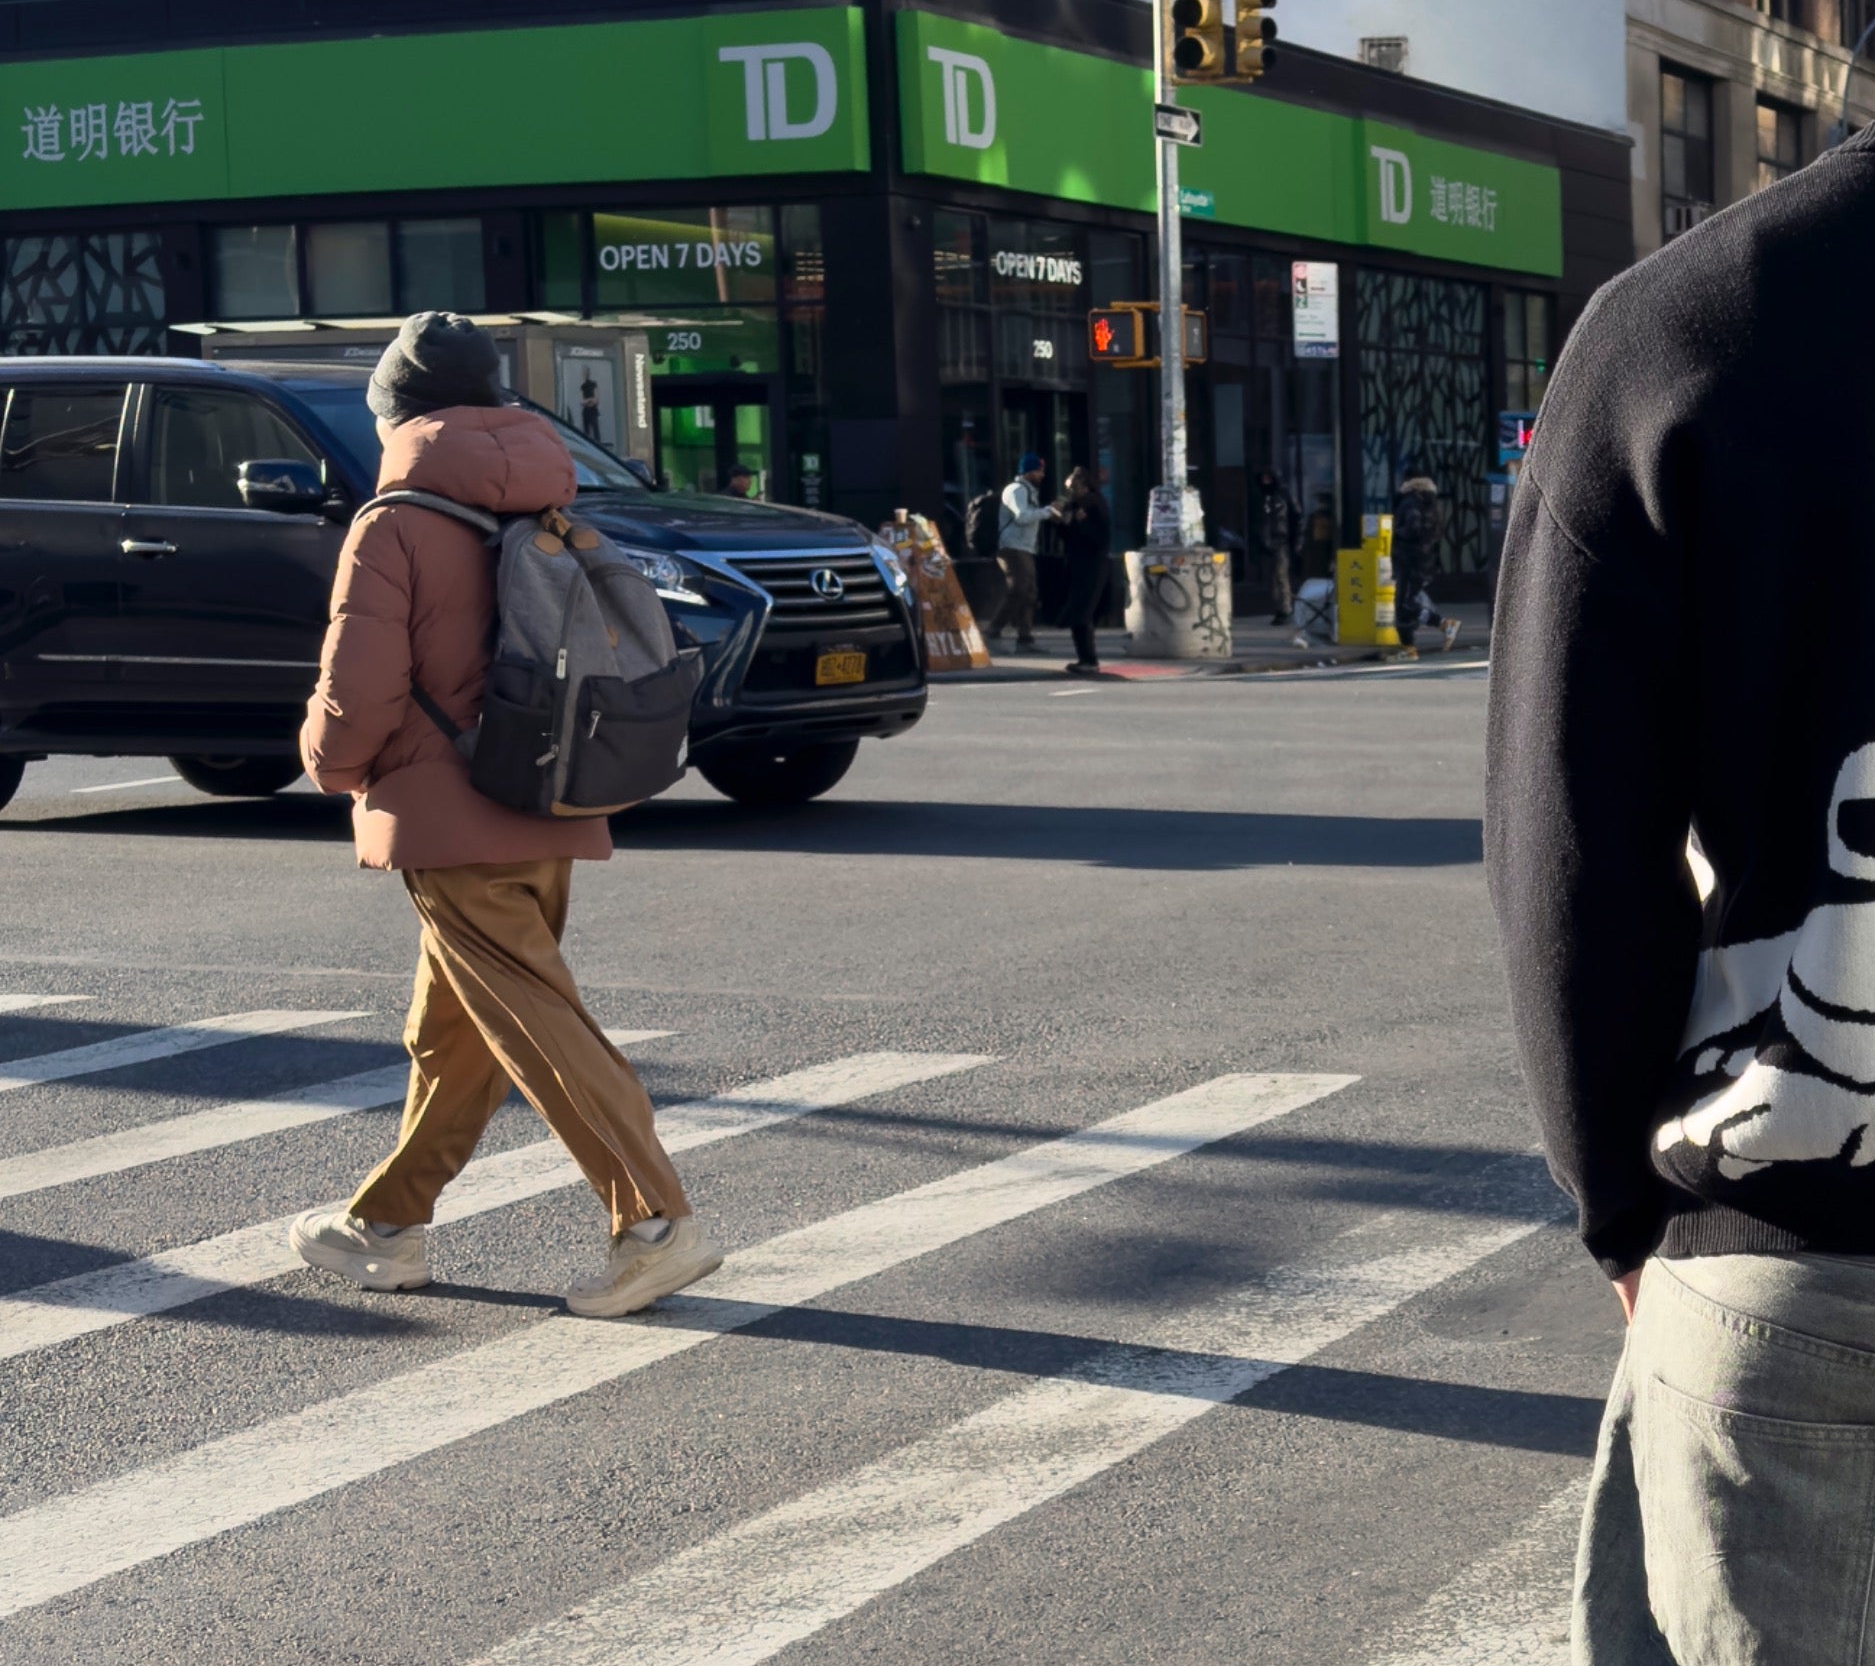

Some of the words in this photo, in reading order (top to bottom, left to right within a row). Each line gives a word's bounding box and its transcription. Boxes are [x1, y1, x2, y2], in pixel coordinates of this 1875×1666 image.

[718, 41, 838, 141] TD
[926, 44, 997, 150] TD
[20, 97, 205, 162] 道明银行
[1369, 144, 1413, 225] TD
[600, 244, 670, 271] OPEN
[675, 243, 690, 268] 7
[696, 241, 762, 268] DAYS
[996, 250, 1035, 280] OPEN
[1036, 256, 1047, 281] 7
[1047, 257, 1082, 285] DAYS
[667, 332, 702, 352] 250
[1033, 339, 1053, 359] 250
